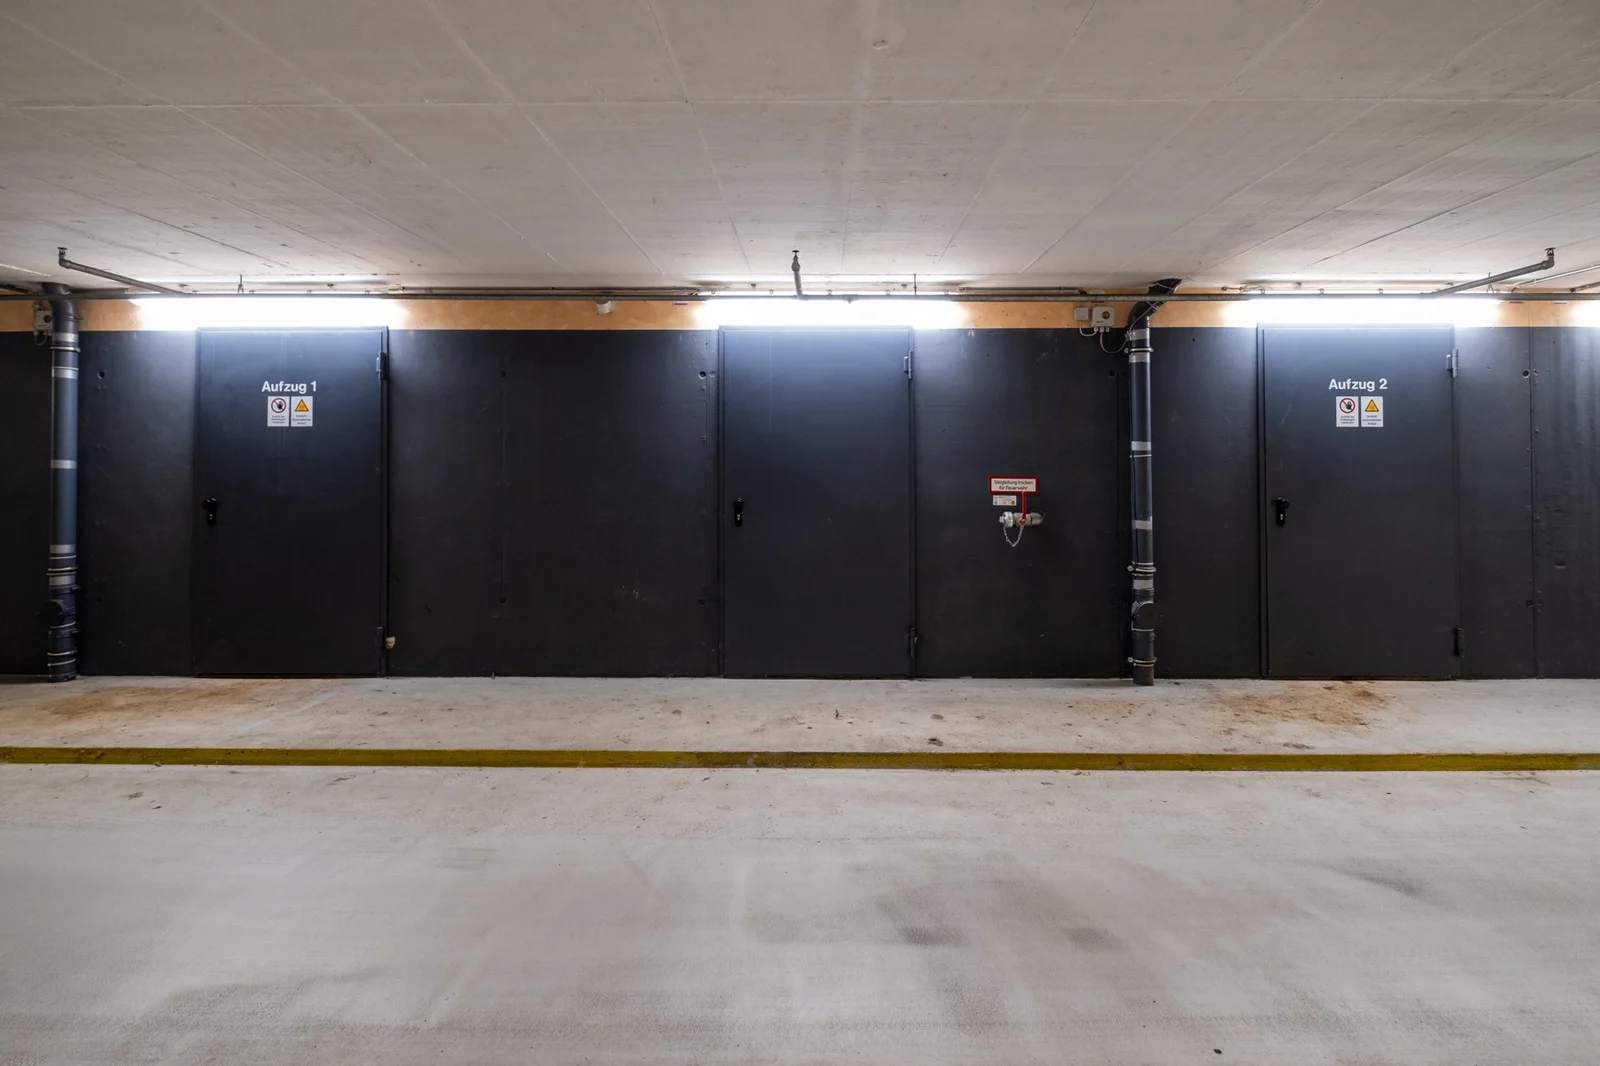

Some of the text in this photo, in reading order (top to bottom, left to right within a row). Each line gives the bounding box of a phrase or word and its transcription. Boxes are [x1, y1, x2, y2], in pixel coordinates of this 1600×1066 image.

[261, 380, 317, 394] Aufzug 1
[1328, 378, 1388, 392] Aufzug 2
